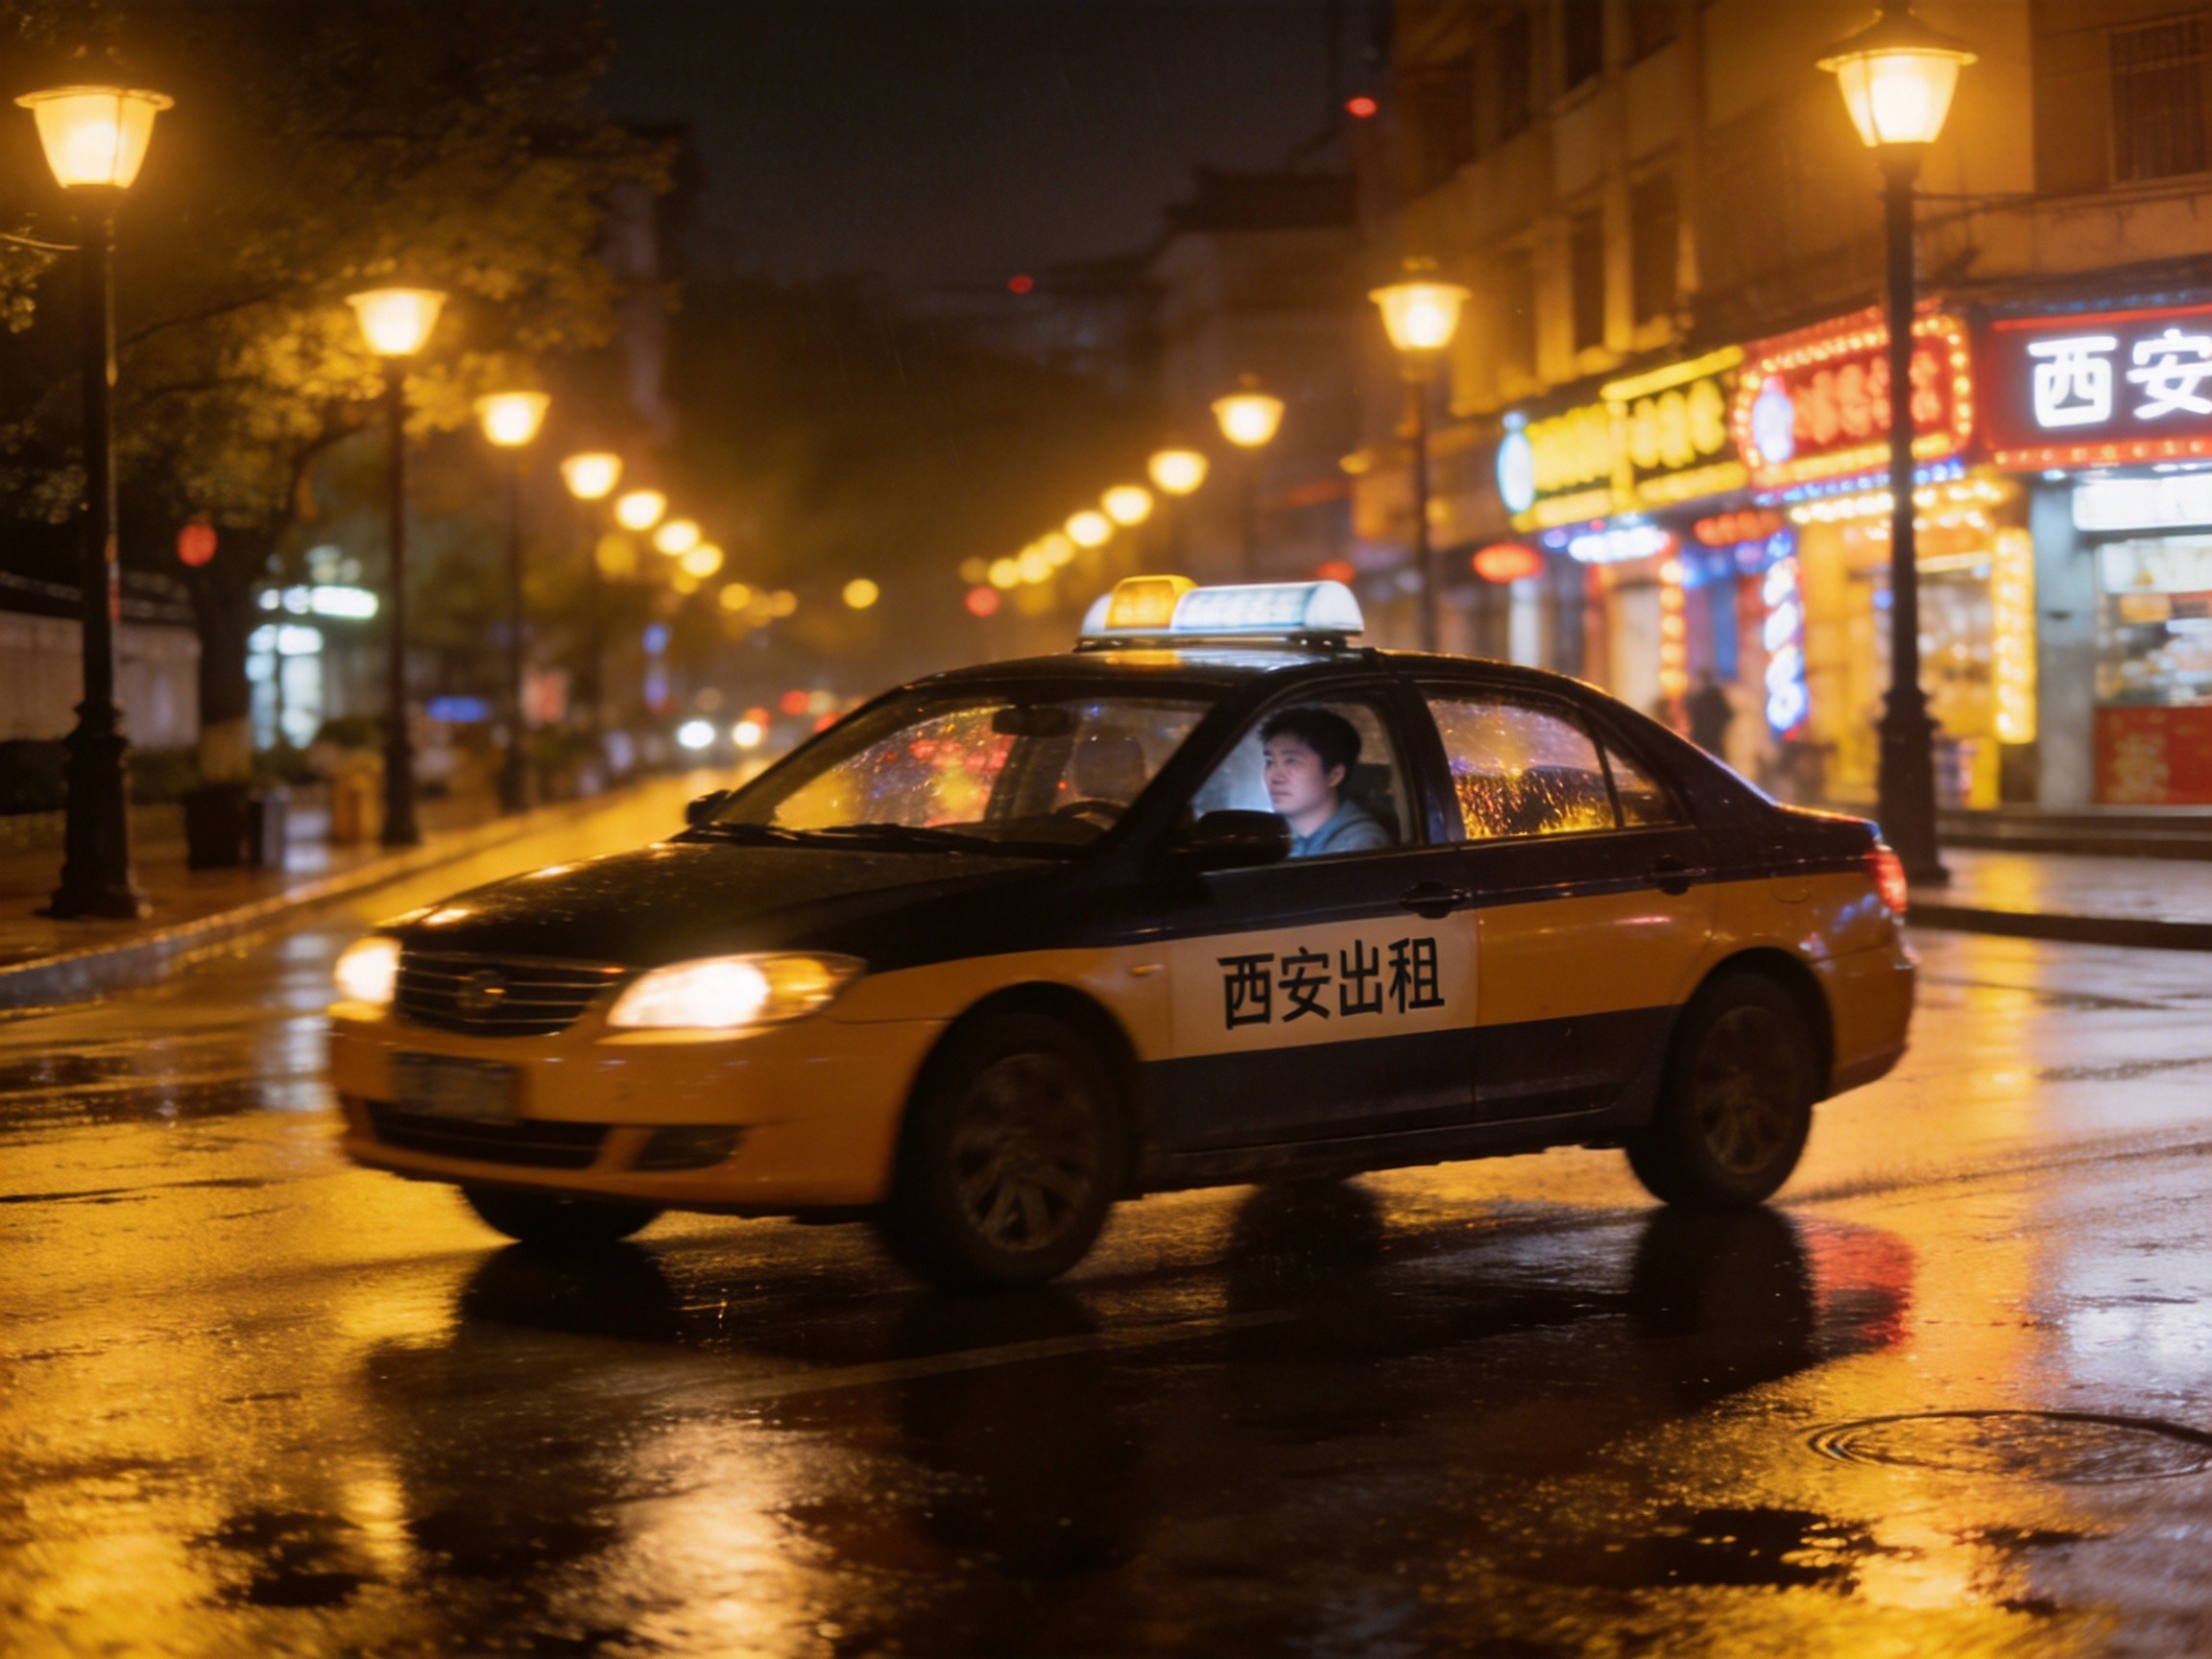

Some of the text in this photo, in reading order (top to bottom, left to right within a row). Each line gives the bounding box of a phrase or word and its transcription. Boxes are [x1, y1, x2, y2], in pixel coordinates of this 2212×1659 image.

[2028, 327, 2212, 428] 西安
[1216, 936, 1445, 1030] 西安出租
